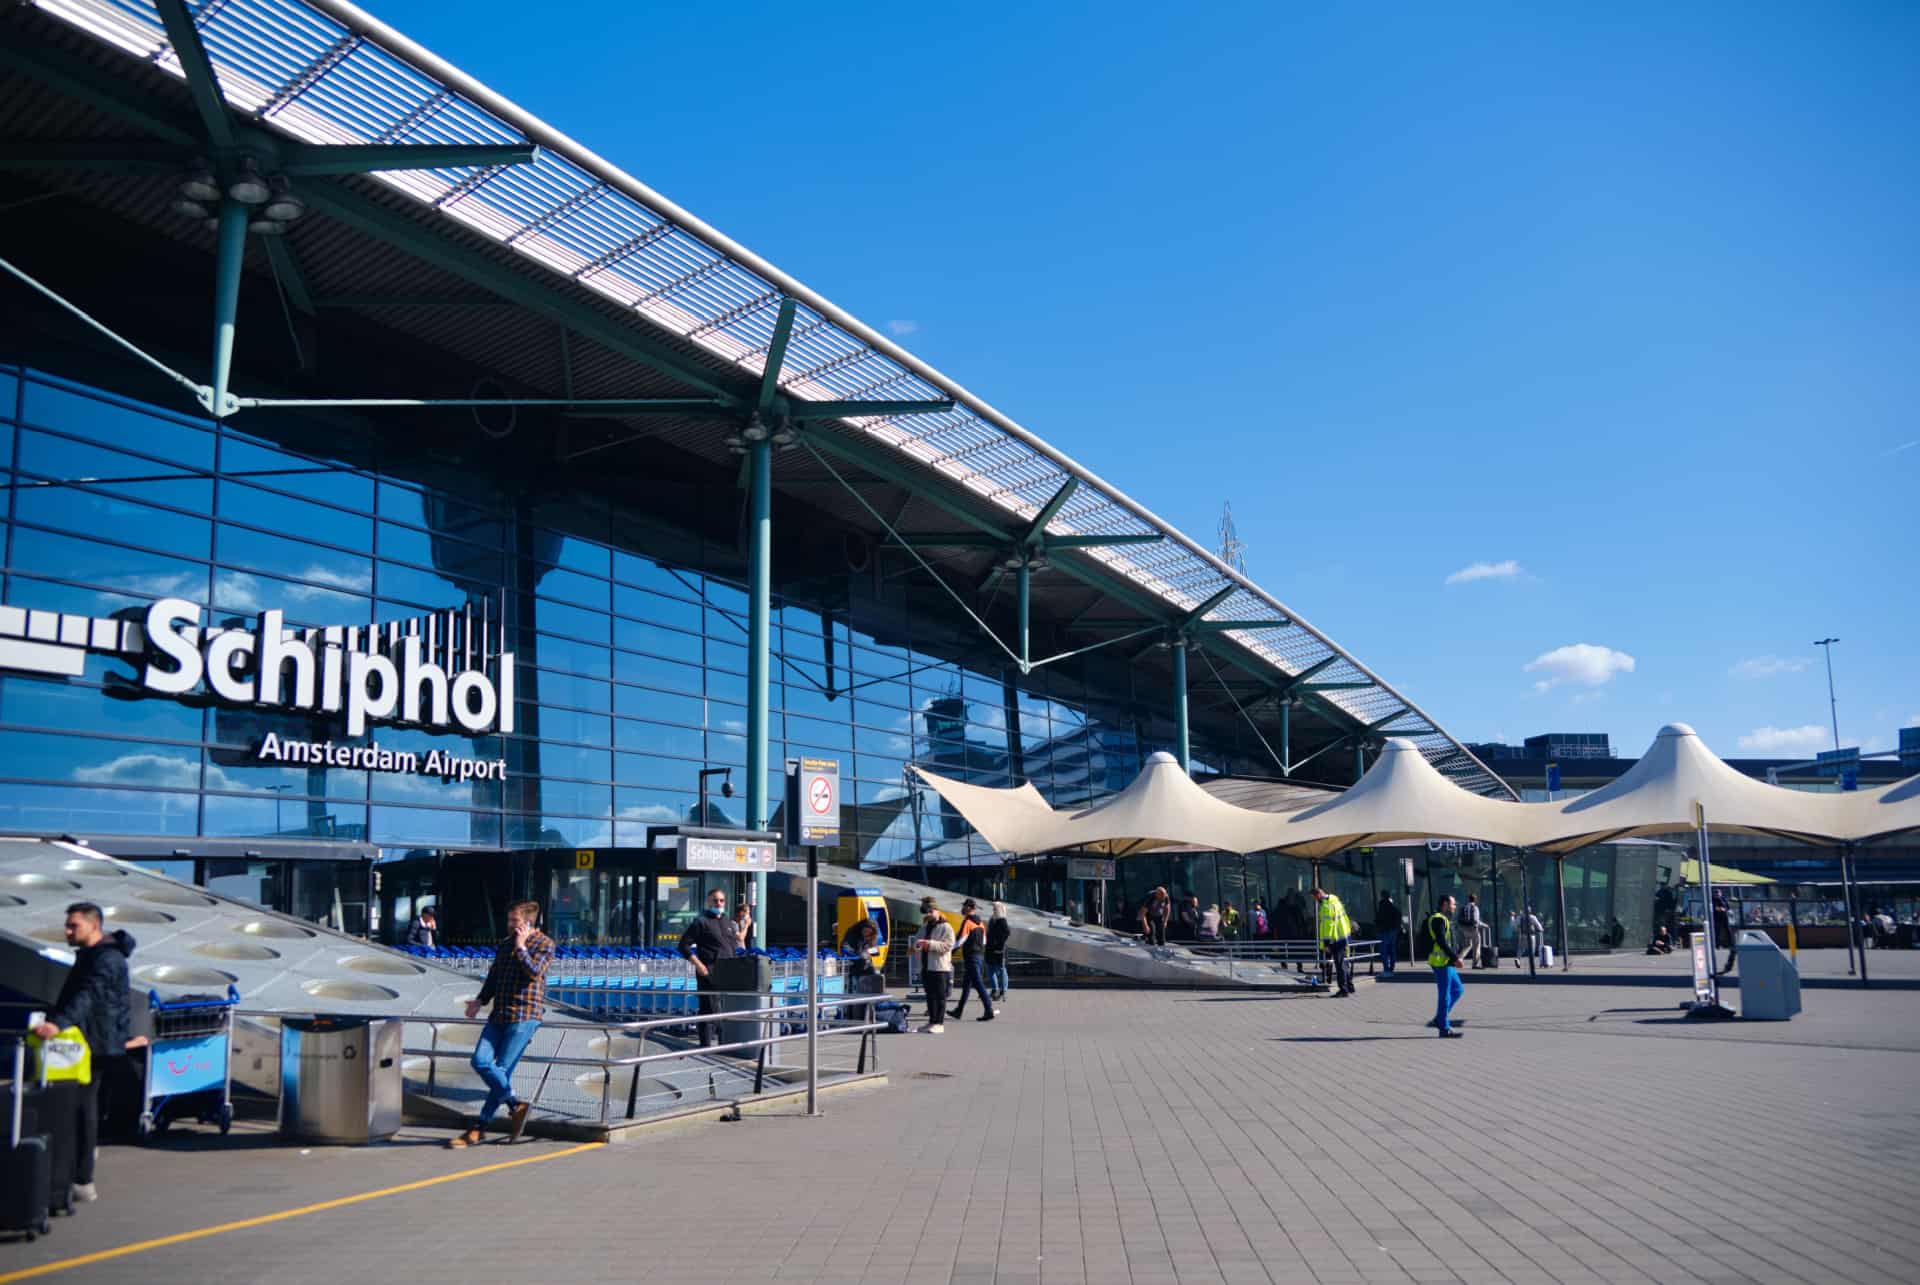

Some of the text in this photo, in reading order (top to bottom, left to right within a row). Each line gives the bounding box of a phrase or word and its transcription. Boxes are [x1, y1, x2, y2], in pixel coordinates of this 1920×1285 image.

[145, 598, 514, 736] Schiphol
[259, 732, 506, 783] Amsterdam Airport
[580, 853, 591, 867] D
